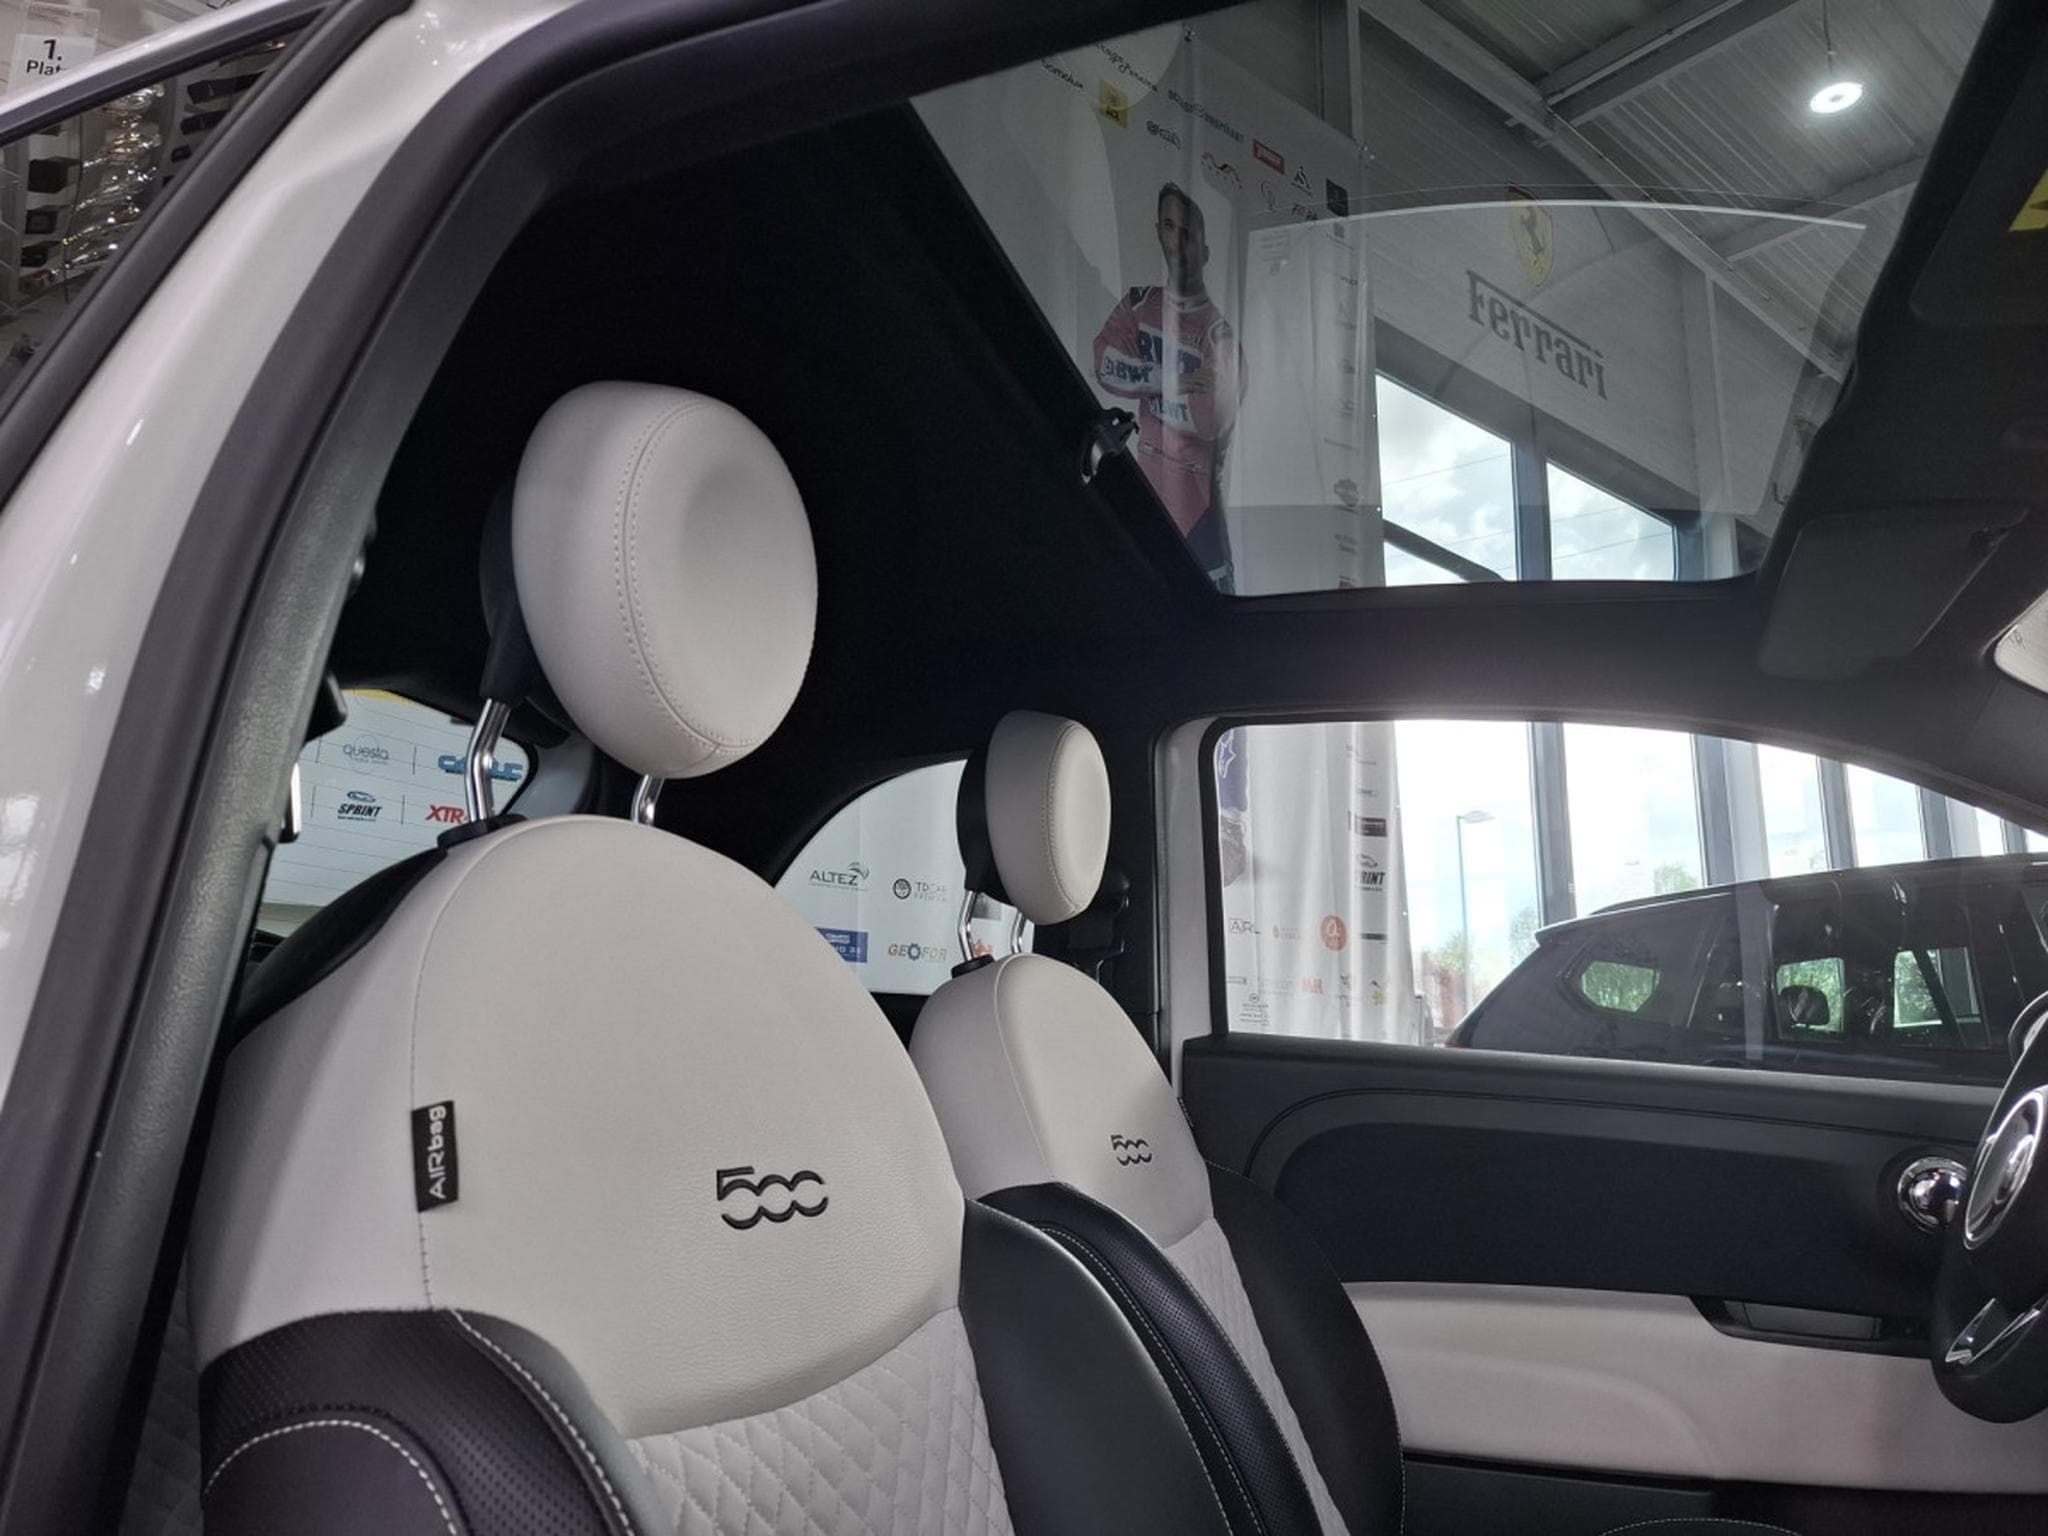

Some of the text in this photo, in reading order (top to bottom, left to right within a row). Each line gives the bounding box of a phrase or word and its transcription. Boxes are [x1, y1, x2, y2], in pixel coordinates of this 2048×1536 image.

[43, 38, 62, 61] 1.
[26, 59, 67, 76] Plat
[1466, 269, 1608, 401] Ferrari
[337, 803, 383, 818] SPRINT
[424, 804, 469, 824] XTR
[809, 869, 859, 887] ALTEZ
[1359, 870, 1386, 886] RINT
[426, 1104, 448, 1200] AIRbag
[1110, 1134, 1153, 1166] 500
[716, 1165, 829, 1230] 500
